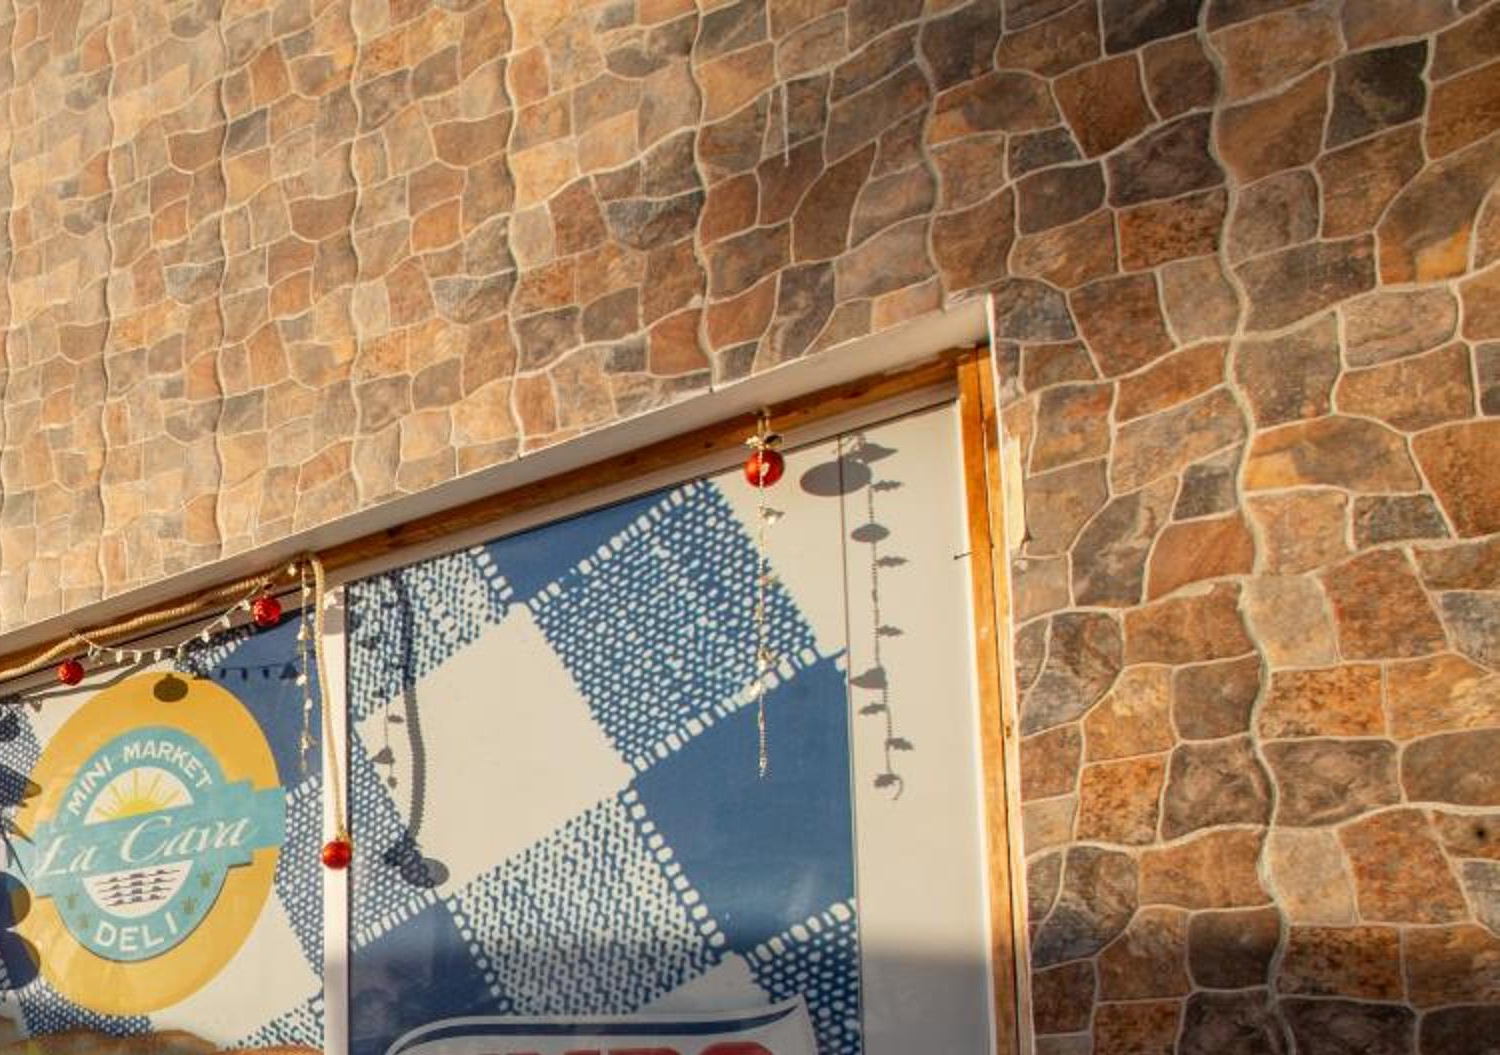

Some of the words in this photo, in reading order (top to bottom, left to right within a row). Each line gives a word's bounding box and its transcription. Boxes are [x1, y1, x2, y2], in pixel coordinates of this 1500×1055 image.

[67, 756, 114, 815] MINI
[122, 739, 213, 789] MARKET
[34, 833, 97, 878] La
[120, 815, 258, 863] Cava
[95, 911, 180, 952] DELI
